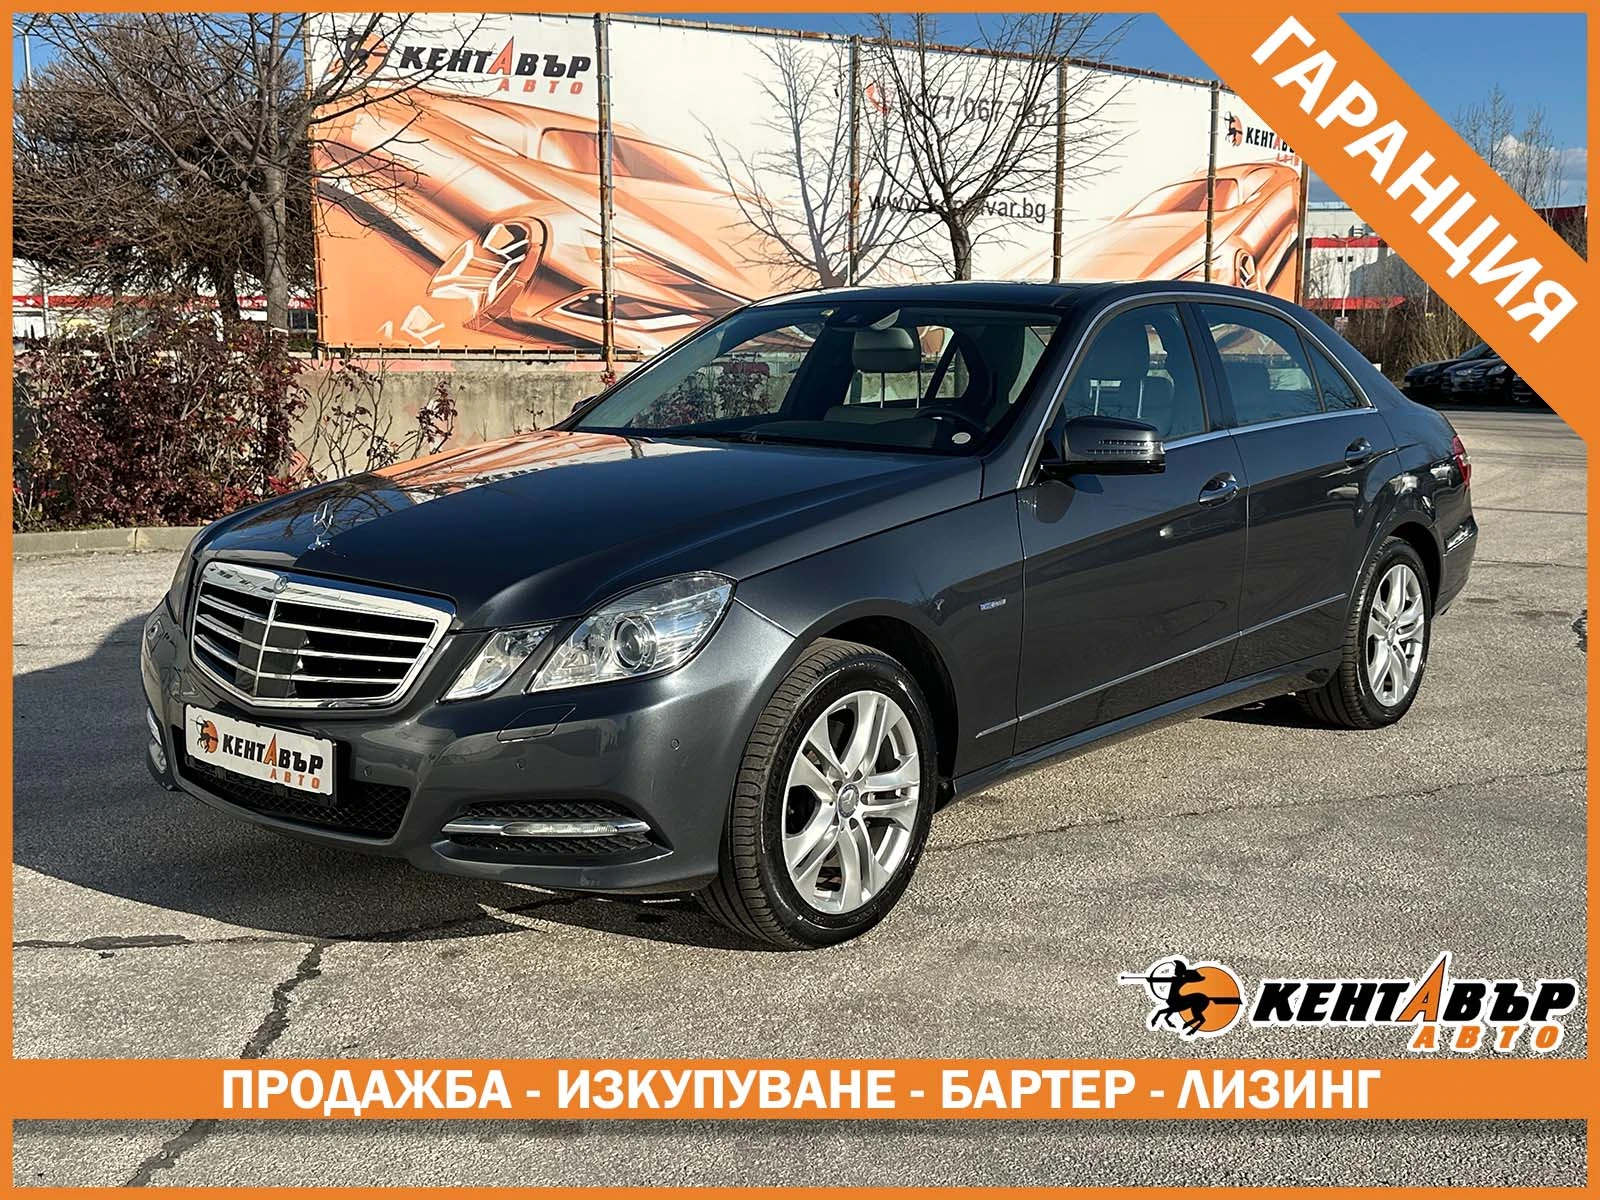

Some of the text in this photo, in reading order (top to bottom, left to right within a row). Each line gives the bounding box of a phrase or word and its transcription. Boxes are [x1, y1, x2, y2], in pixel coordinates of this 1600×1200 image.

[399, 36, 591, 78] КЕНТАВЪР
[498, 79, 584, 95] АВТО
[1245, 126, 1295, 153] КЕНТАВ
[222, 733, 324, 775] КЕНТАВЪР
[270, 768, 321, 789] АВТО
